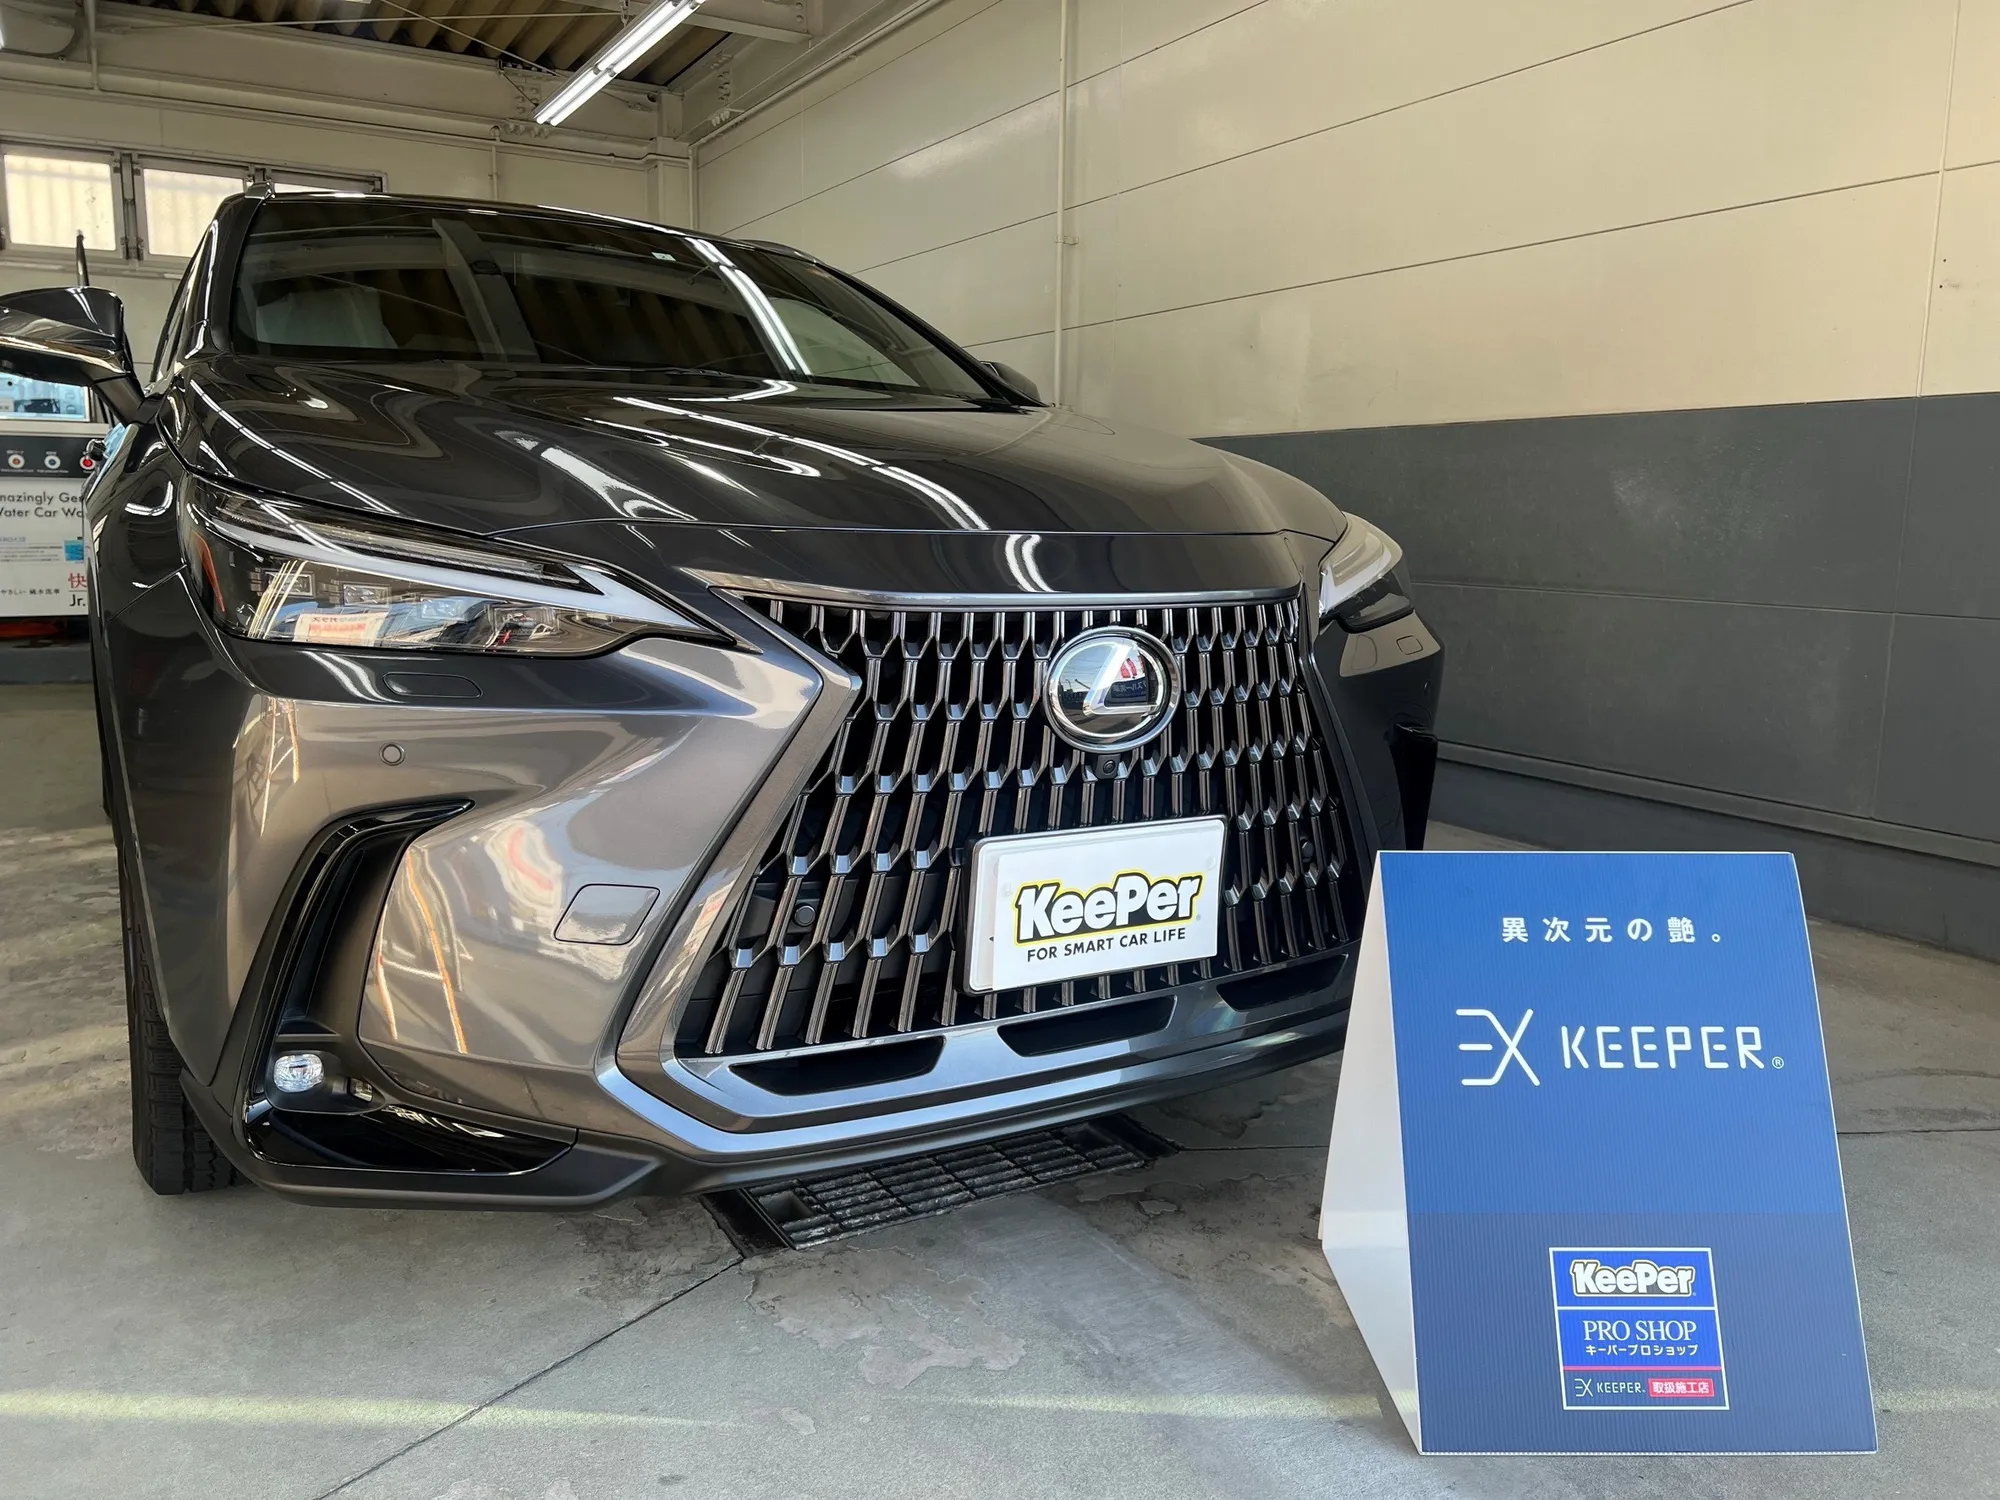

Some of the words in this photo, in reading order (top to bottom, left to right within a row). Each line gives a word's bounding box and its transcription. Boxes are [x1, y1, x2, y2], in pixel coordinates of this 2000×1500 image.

[34, 507, 57, 518] Car
[69, 594, 87, 607] Jr.
[1015, 872, 1204, 943] KeePer
[1501, 916, 1721, 943] 異次元の艶。
[1027, 947, 1057, 962] FOR
[1064, 937, 1114, 956] SMART
[1119, 932, 1148, 948] CAR
[1153, 927, 1186, 943] LIFE
[1571, 1260, 1695, 1297] KeePer
[1583, 1320, 1630, 1341] PRO
[1635, 1320, 1697, 1341] SHOP
[1585, 1344, 1699, 1356] キーバープロショップ
[1652, 1381, 1710, 1394] 取扱施工店
